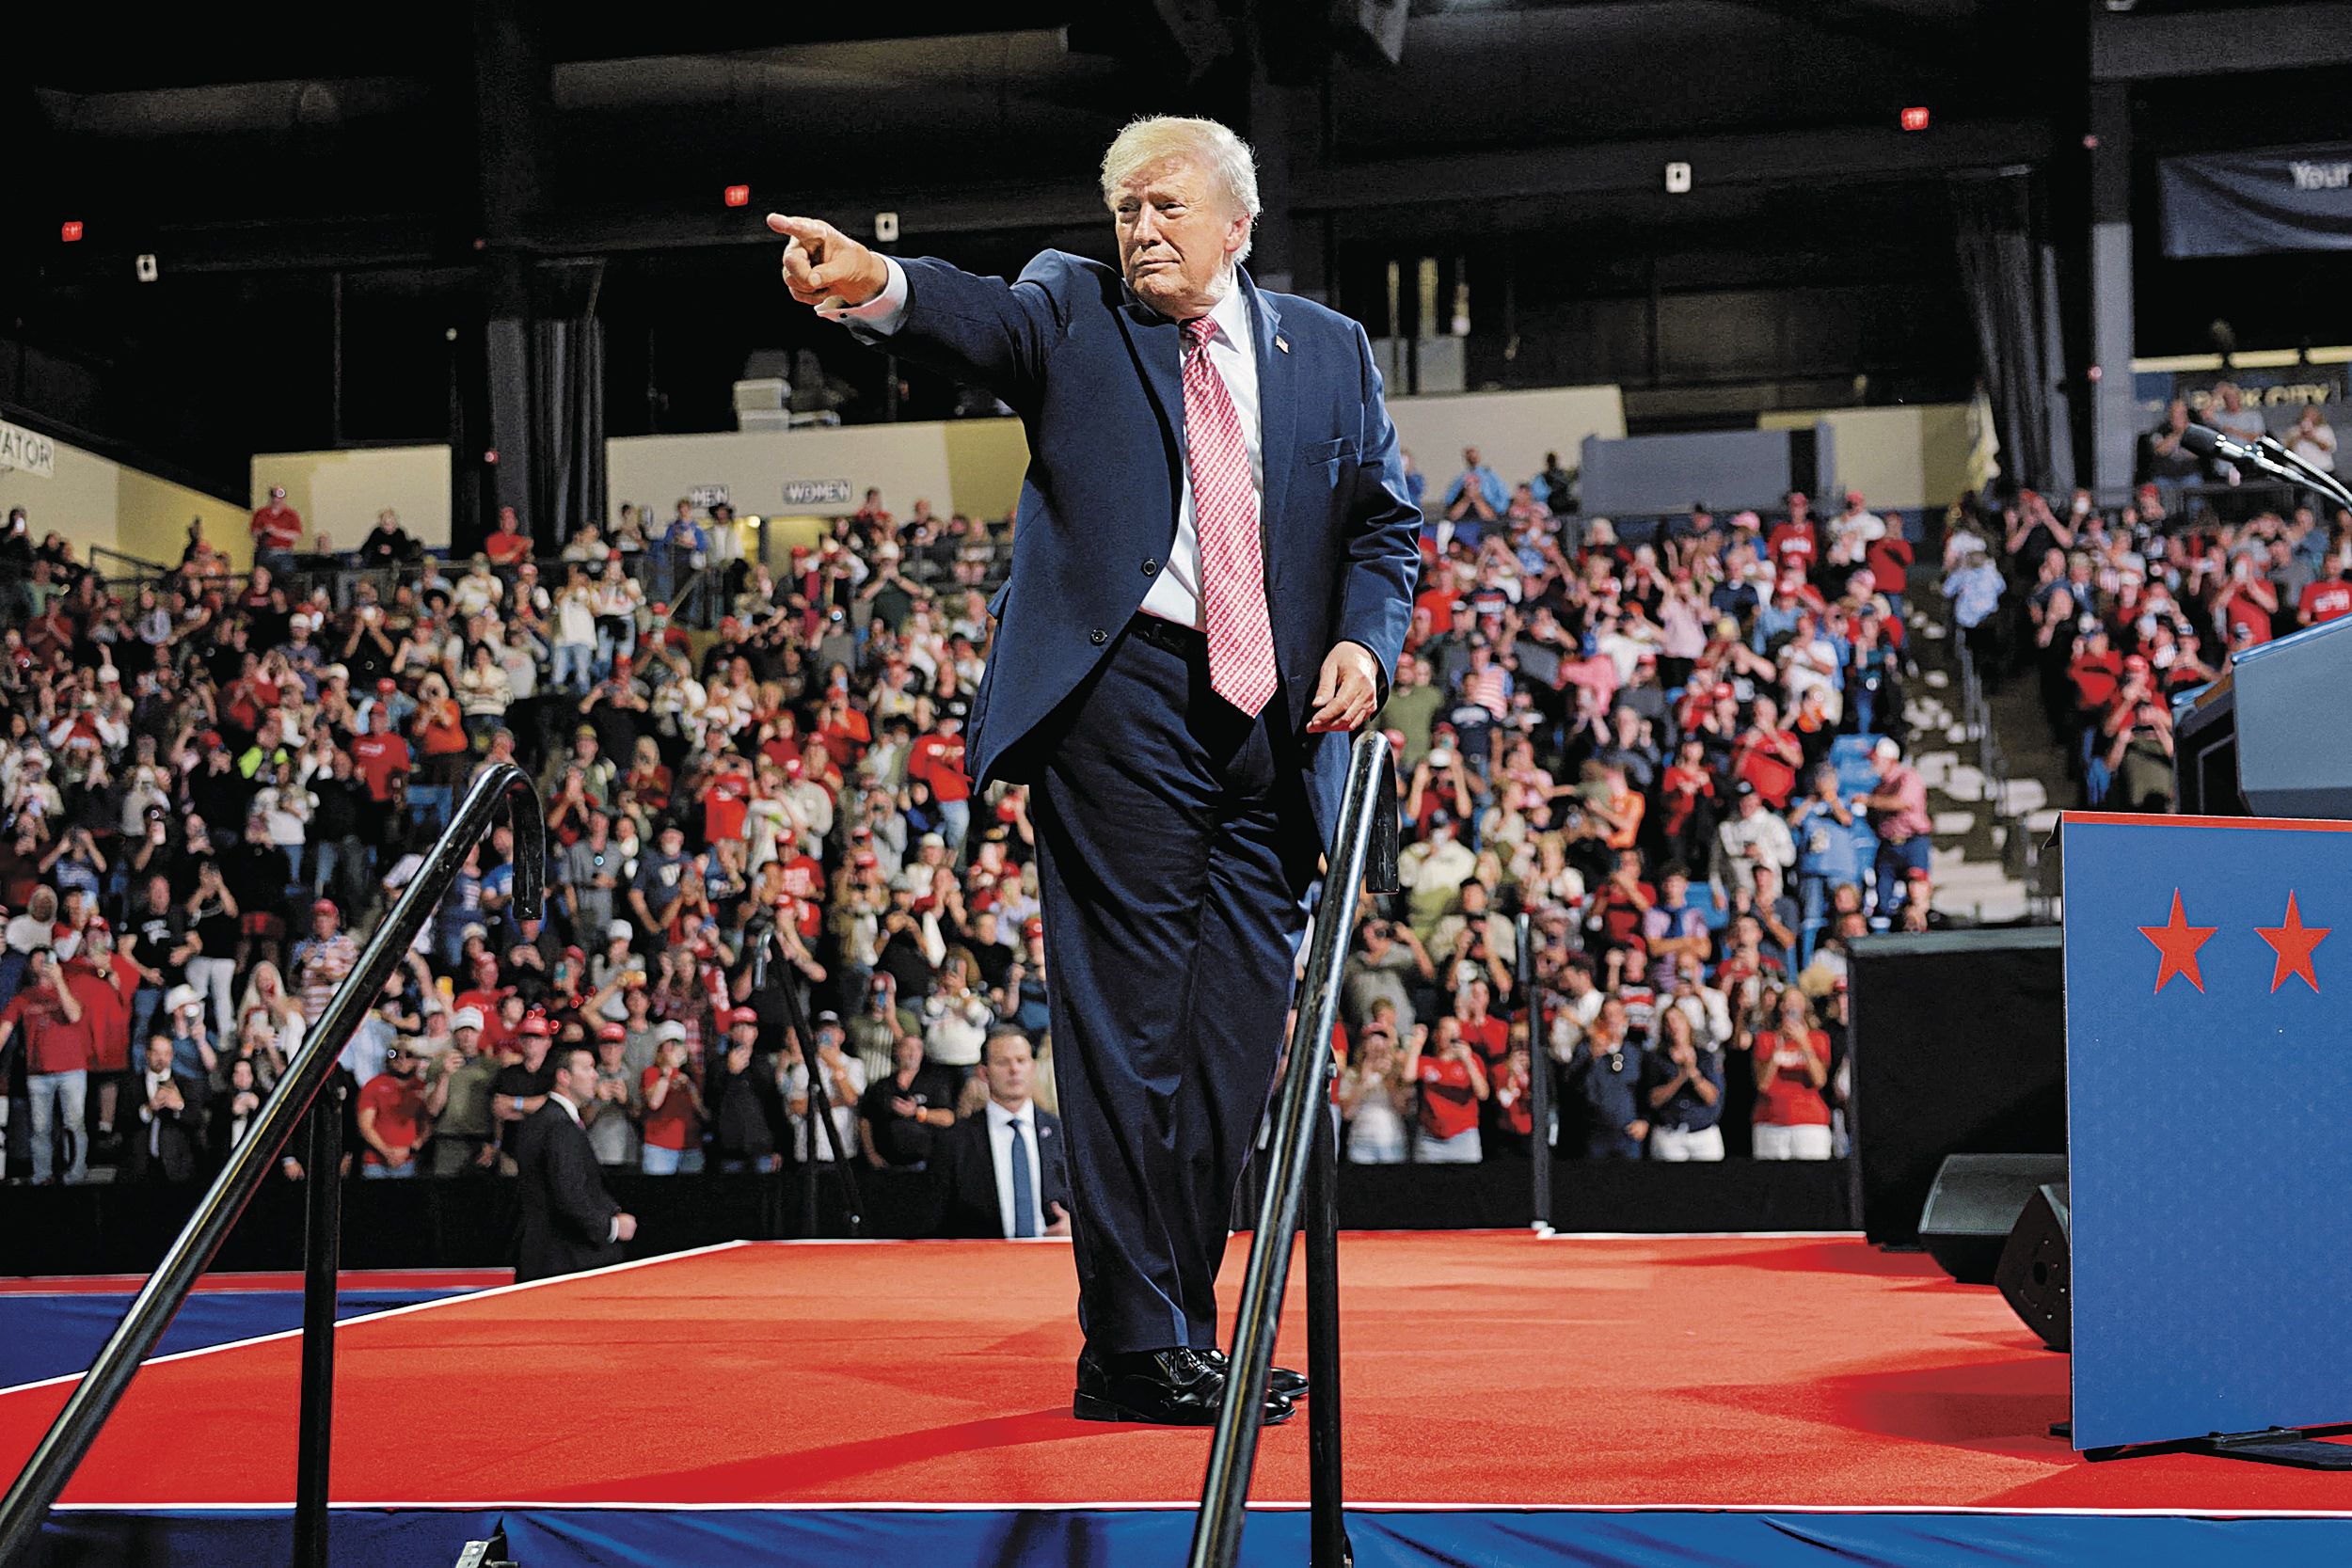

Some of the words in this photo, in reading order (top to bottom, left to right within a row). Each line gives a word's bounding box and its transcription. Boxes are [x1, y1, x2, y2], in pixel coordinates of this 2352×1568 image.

[0, 430, 53, 470] ATOR
[693, 487, 728, 505] MEN
[787, 482, 850, 500] WOMEN
